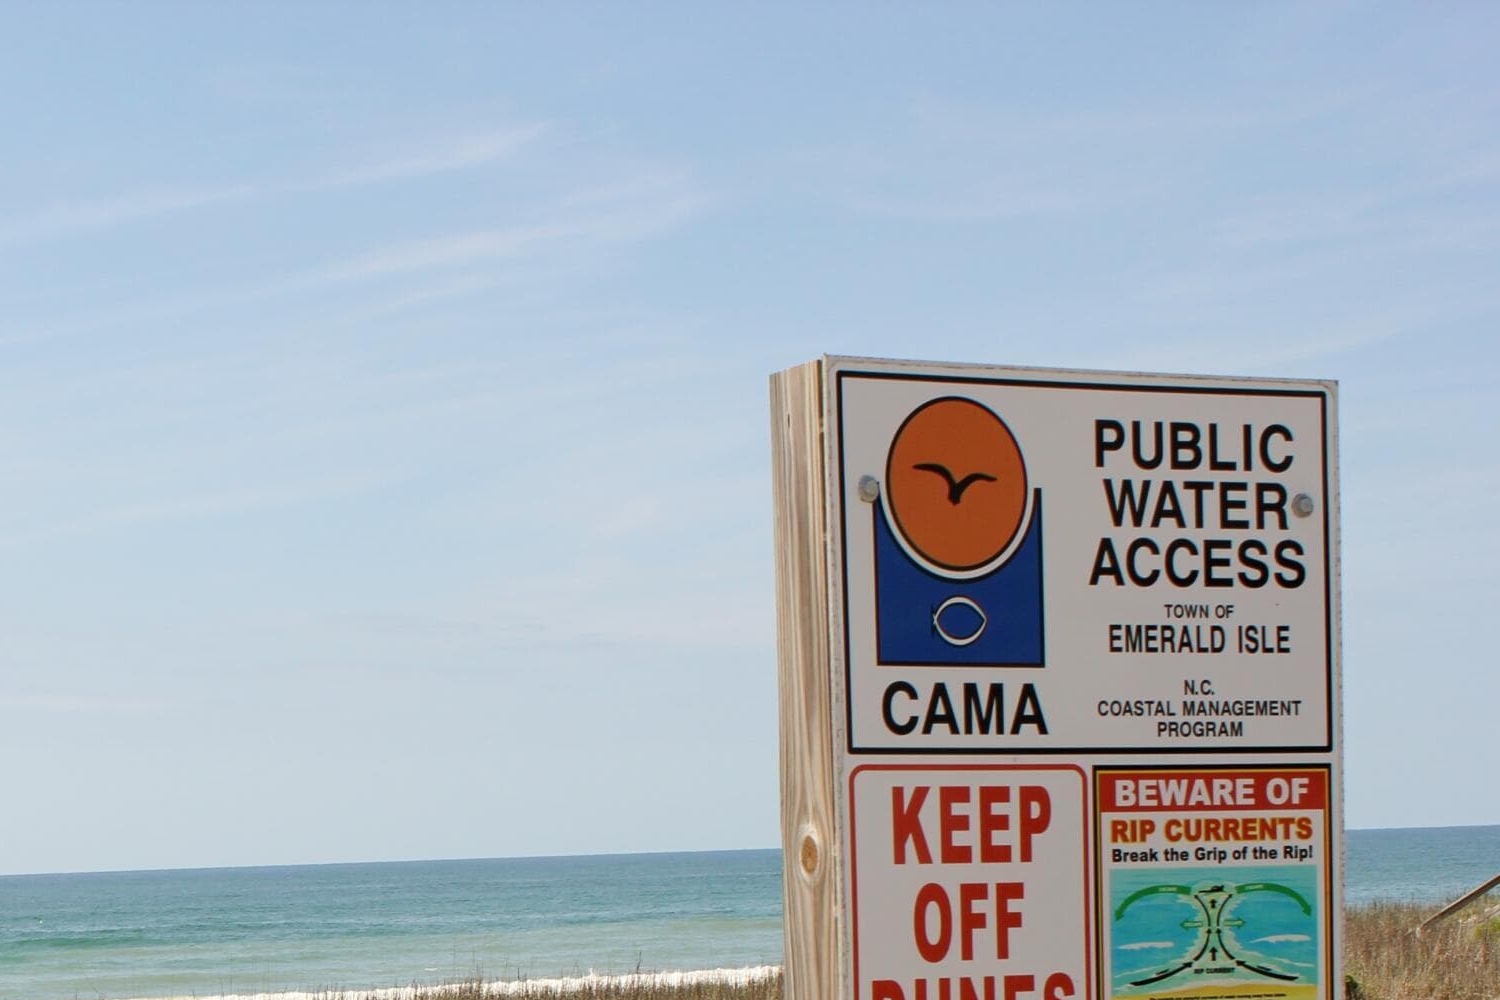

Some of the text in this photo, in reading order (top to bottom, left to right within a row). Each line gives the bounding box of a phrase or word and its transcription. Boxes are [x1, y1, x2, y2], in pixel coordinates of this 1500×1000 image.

[1094, 419, 1294, 472] PUBLIC
[1103, 479, 1289, 530] WATER
[1089, 538, 1306, 588] ACCESS
[1164, 604, 1234, 618] TOWN OF
[1109, 624, 1290, 653] EMERALD ISLE
[1184, 680, 1215, 695] N.C.
[882, 681, 1049, 735] CAMA
[1098, 701, 1301, 716] COASTAL MANAGEMENT
[1157, 722, 1243, 737] PROGRAM
[1115, 778, 1309, 806] BEWARE OF
[892, 785, 1052, 864] KEEP
[1111, 817, 1313, 843] RIP CURRENTS
[1112, 845, 1313, 863] Break the Grip of the Rip!
[914, 882, 1025, 963] OFF
